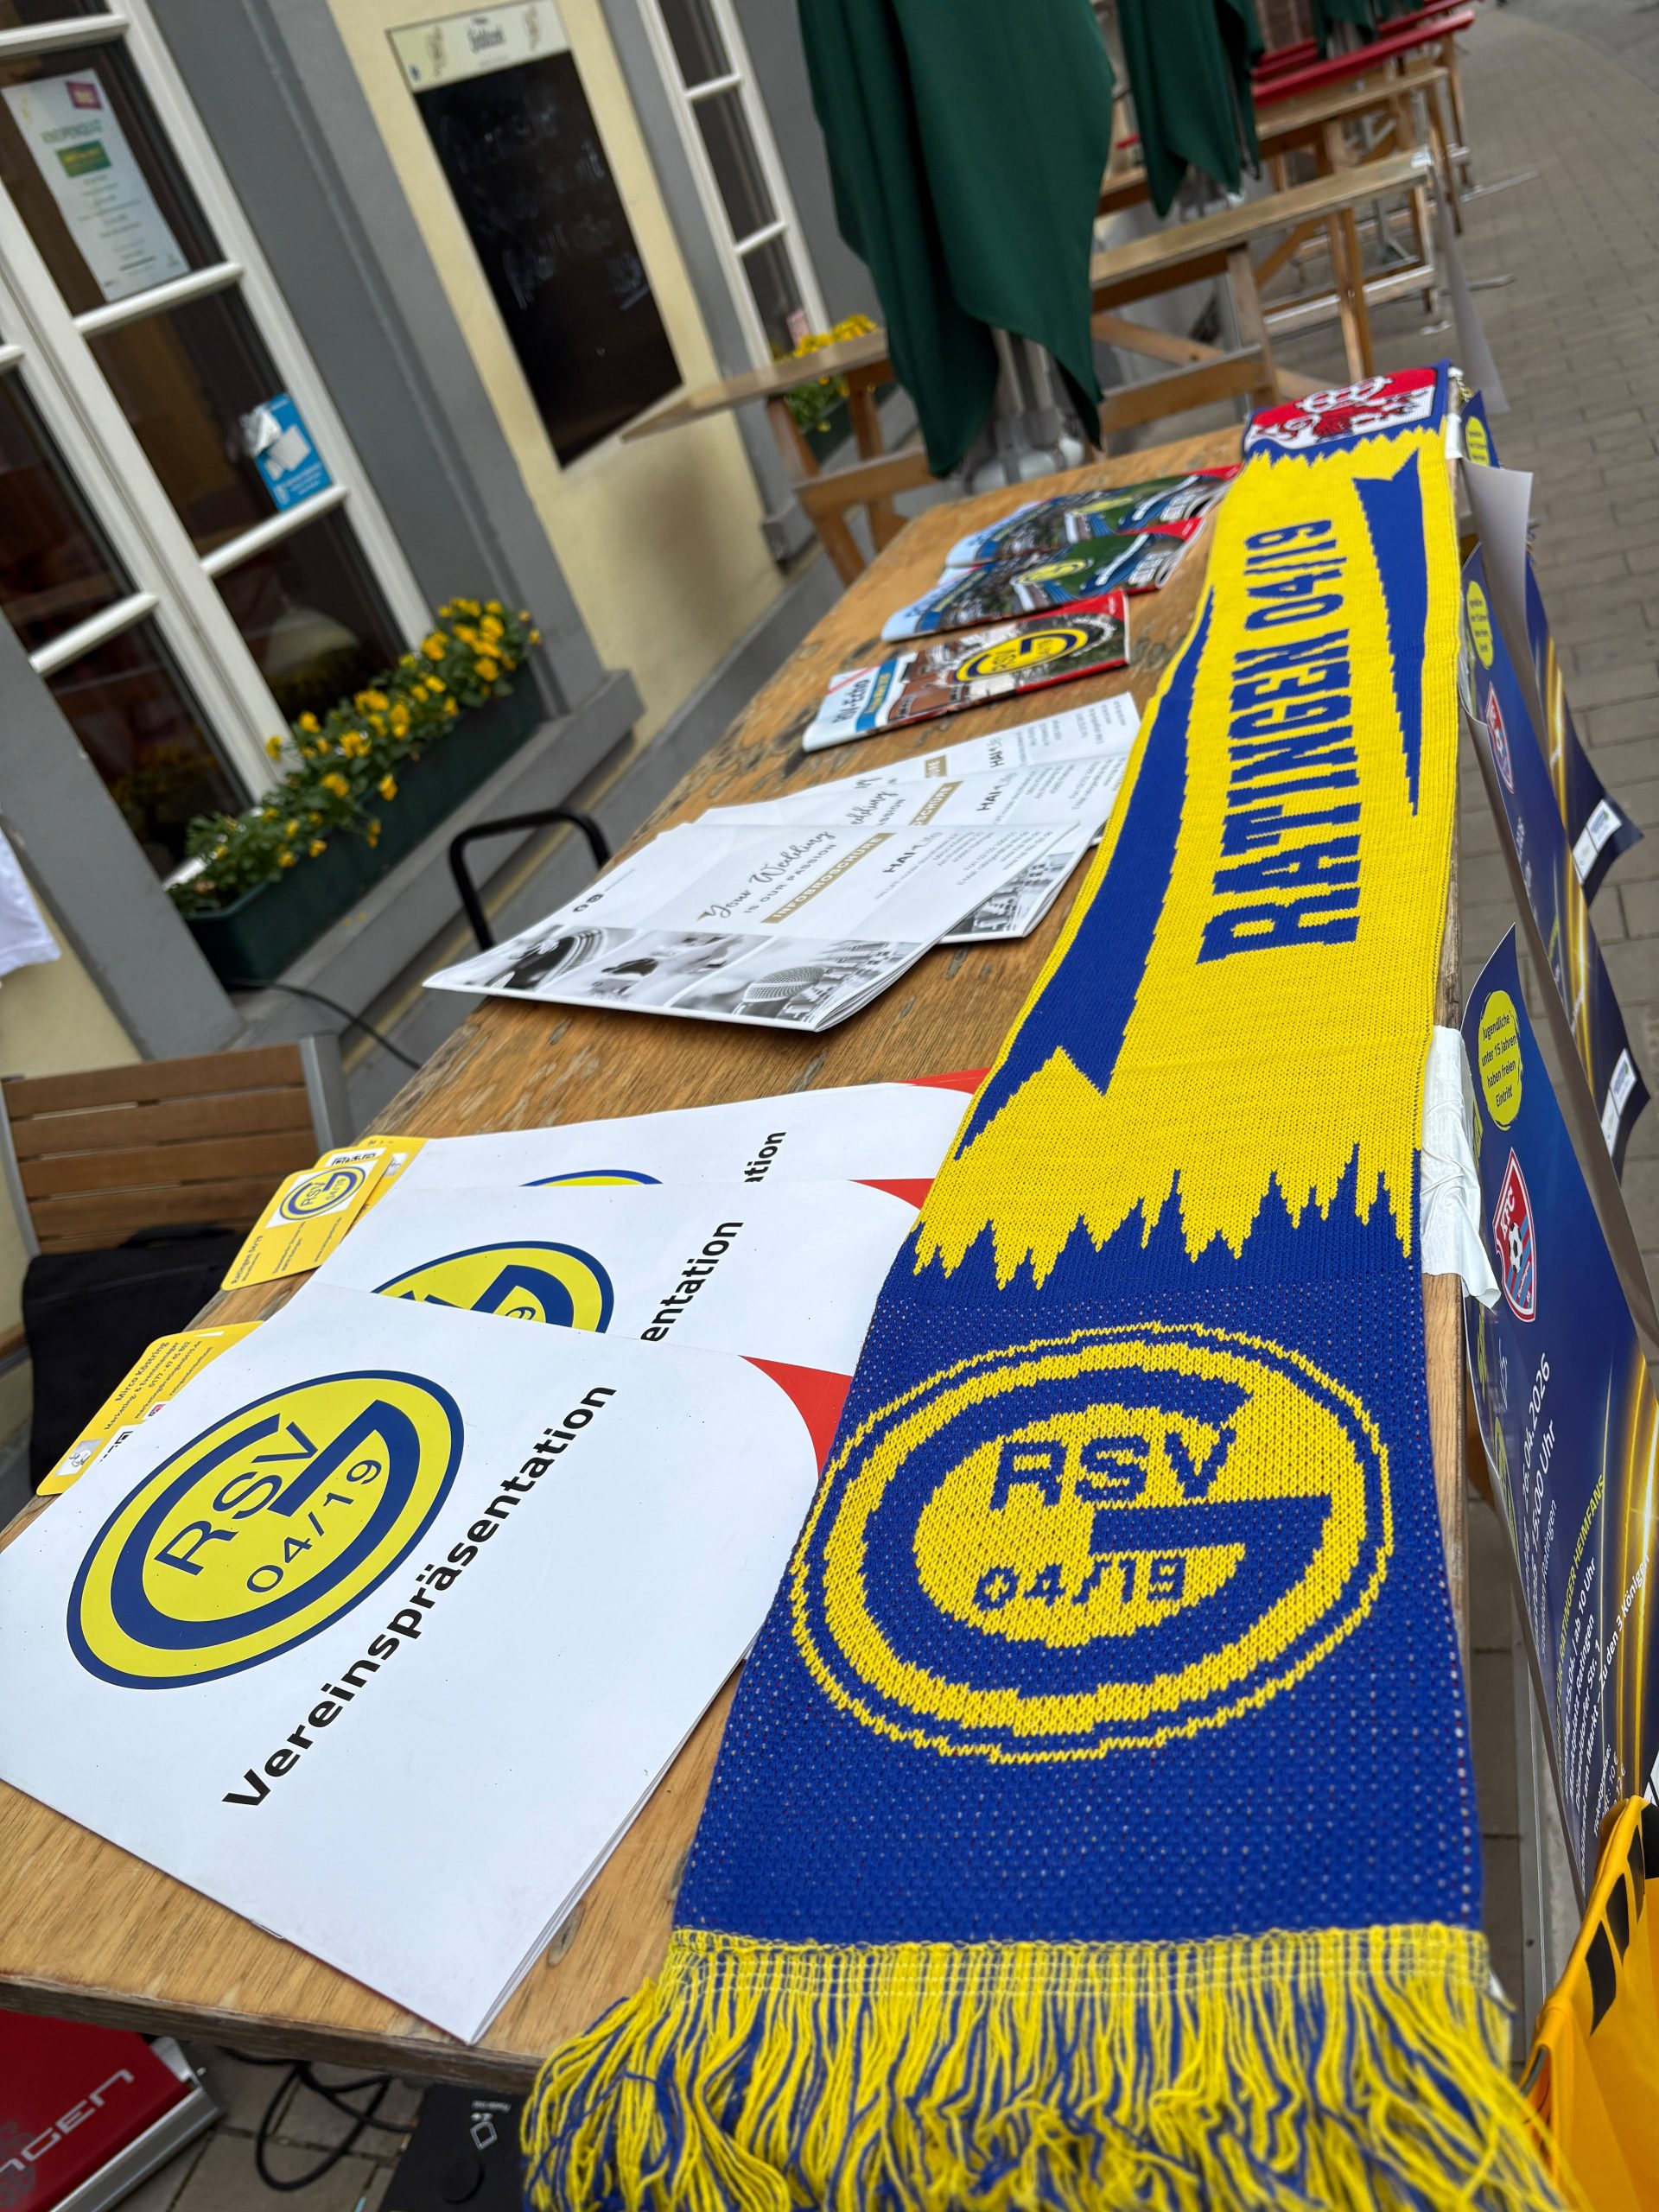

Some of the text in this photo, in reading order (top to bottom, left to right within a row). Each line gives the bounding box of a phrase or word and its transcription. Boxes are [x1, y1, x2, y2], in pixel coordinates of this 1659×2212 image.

[1196, 519, 1363, 965] RATINGER 04/19
[702, 830, 836, 920] Your Wedding
[743, 843, 837, 913] IS OUR PASSION
[776, 836, 885, 918] INFOBROSCHÜRE
[883, 851, 915, 873] HAI
[1481, 1052, 1494, 1067] unter
[1494, 1041, 1501, 1057] 15
[1482, 1014, 1510, 1042] Jugendliche
[1486, 1059, 1516, 1089] haben freien
[1496, 1085, 1513, 1108] Eintritt
[116, 1342, 170, 1402] Mirco Köstring
[988, 1424, 1237, 1513] RSV
[1522, 1352, 1550, 1513] 26.04.2026
[154, 1421, 319, 1577] RSV
[246, 1458, 383, 1593] 04/19
[1531, 1473, 1544, 1553] 15:00
[1539, 1419, 1556, 1475] Uhr
[1542, 1499, 1556, 1585] Ratingen
[1559, 1567, 1577, 1665] RATINGER
[1573, 1474, 1605, 1570] HEIMFANS
[222, 1385, 617, 1806] Vereinspräsentation
[974, 1556, 1188, 1611] 04/19
[1574, 1617, 1581, 1639] ab
[1579, 1590, 1586, 1615] 10
[1584, 1557, 1596, 1590] Uhr
[1617, 1615, 1624, 1631] 3
[1622, 1554, 1649, 1618] Königen
[1606, 1630, 1619, 1665] den
[1569, 1613, 1595, 1805] Marktplatz Ratingen
[1575, 1691, 1590, 1814] Düsseldorfer
[1586, 1659, 1598, 1690] Str.
[1586, 1704, 1599, 1764] Markt
[1583, 1764, 1590, 1796] am
